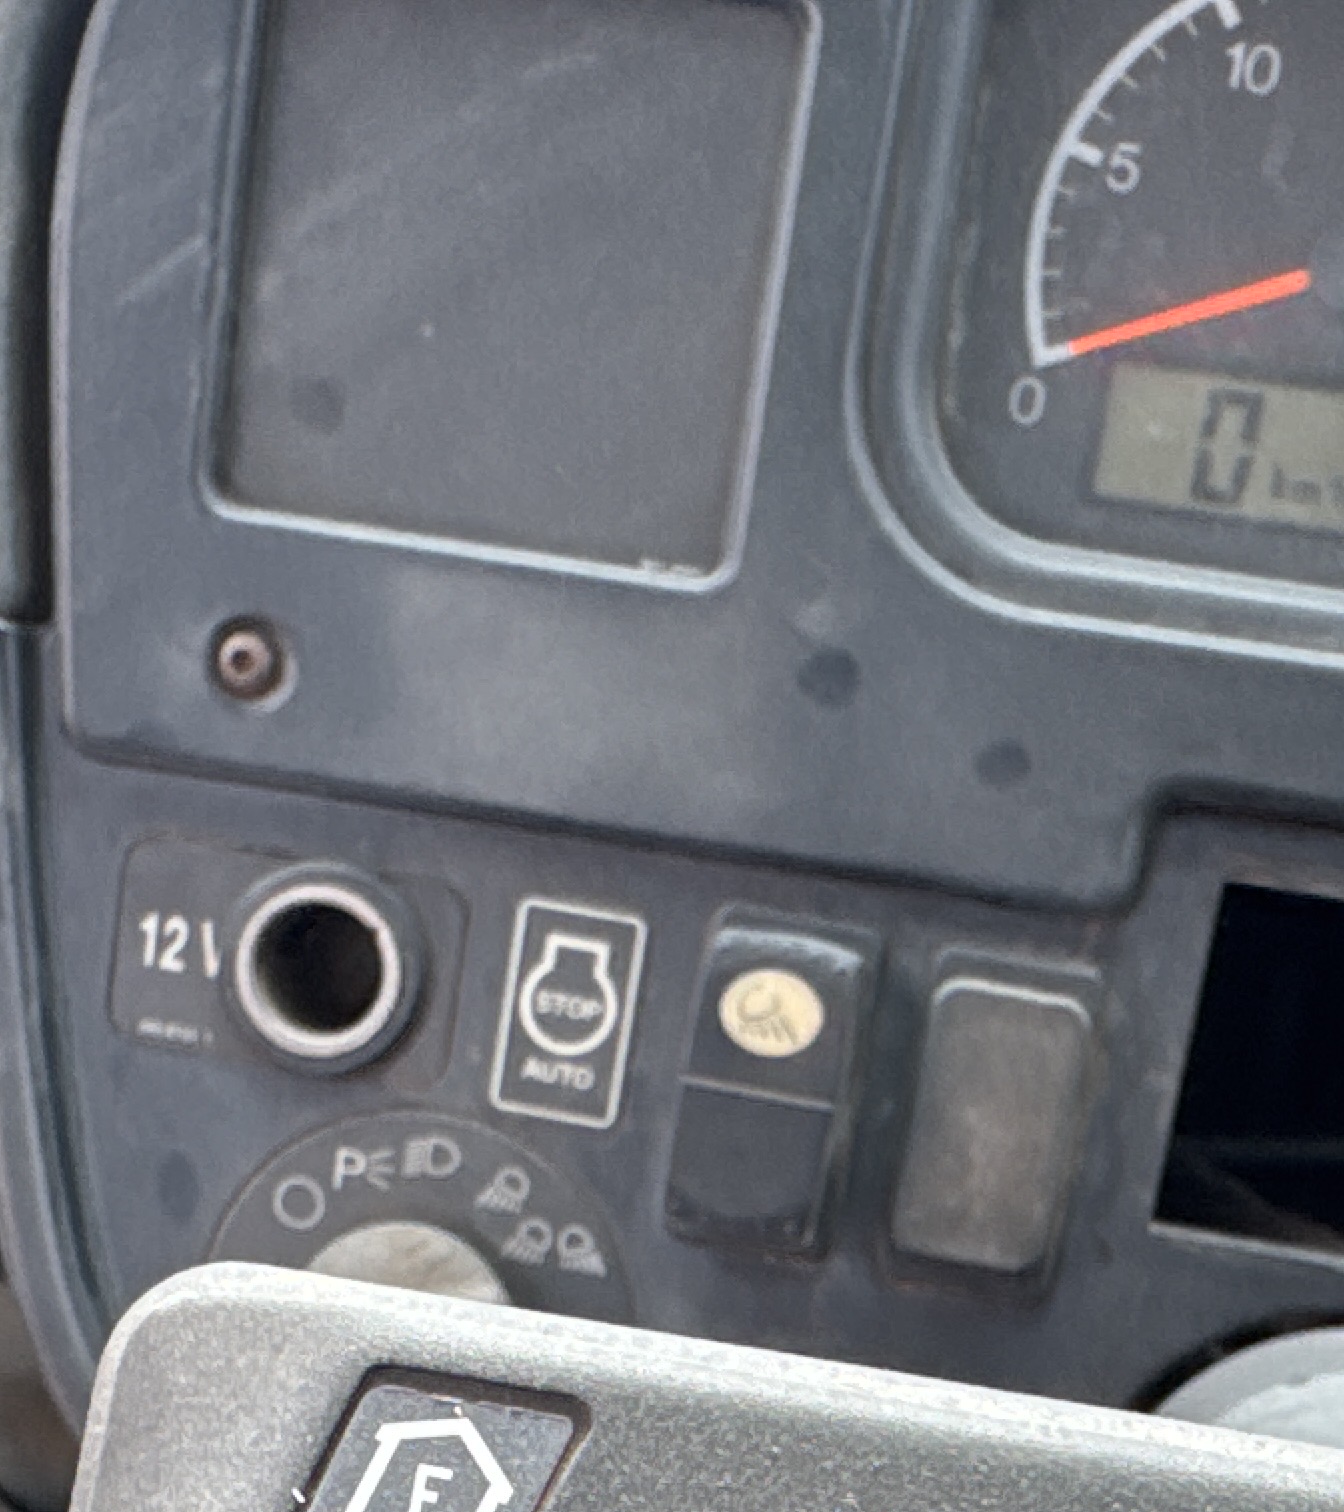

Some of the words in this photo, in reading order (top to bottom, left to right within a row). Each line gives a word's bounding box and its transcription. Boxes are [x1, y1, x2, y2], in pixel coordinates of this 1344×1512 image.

[1226, 43, 1282, 95] 10
[1106, 146, 1140, 192] 5
[1009, 377, 1045, 425] 0
[140, 910, 188, 972] 12
[537, 990, 603, 1020] STOP
[520, 1057, 595, 1090] AUTO
